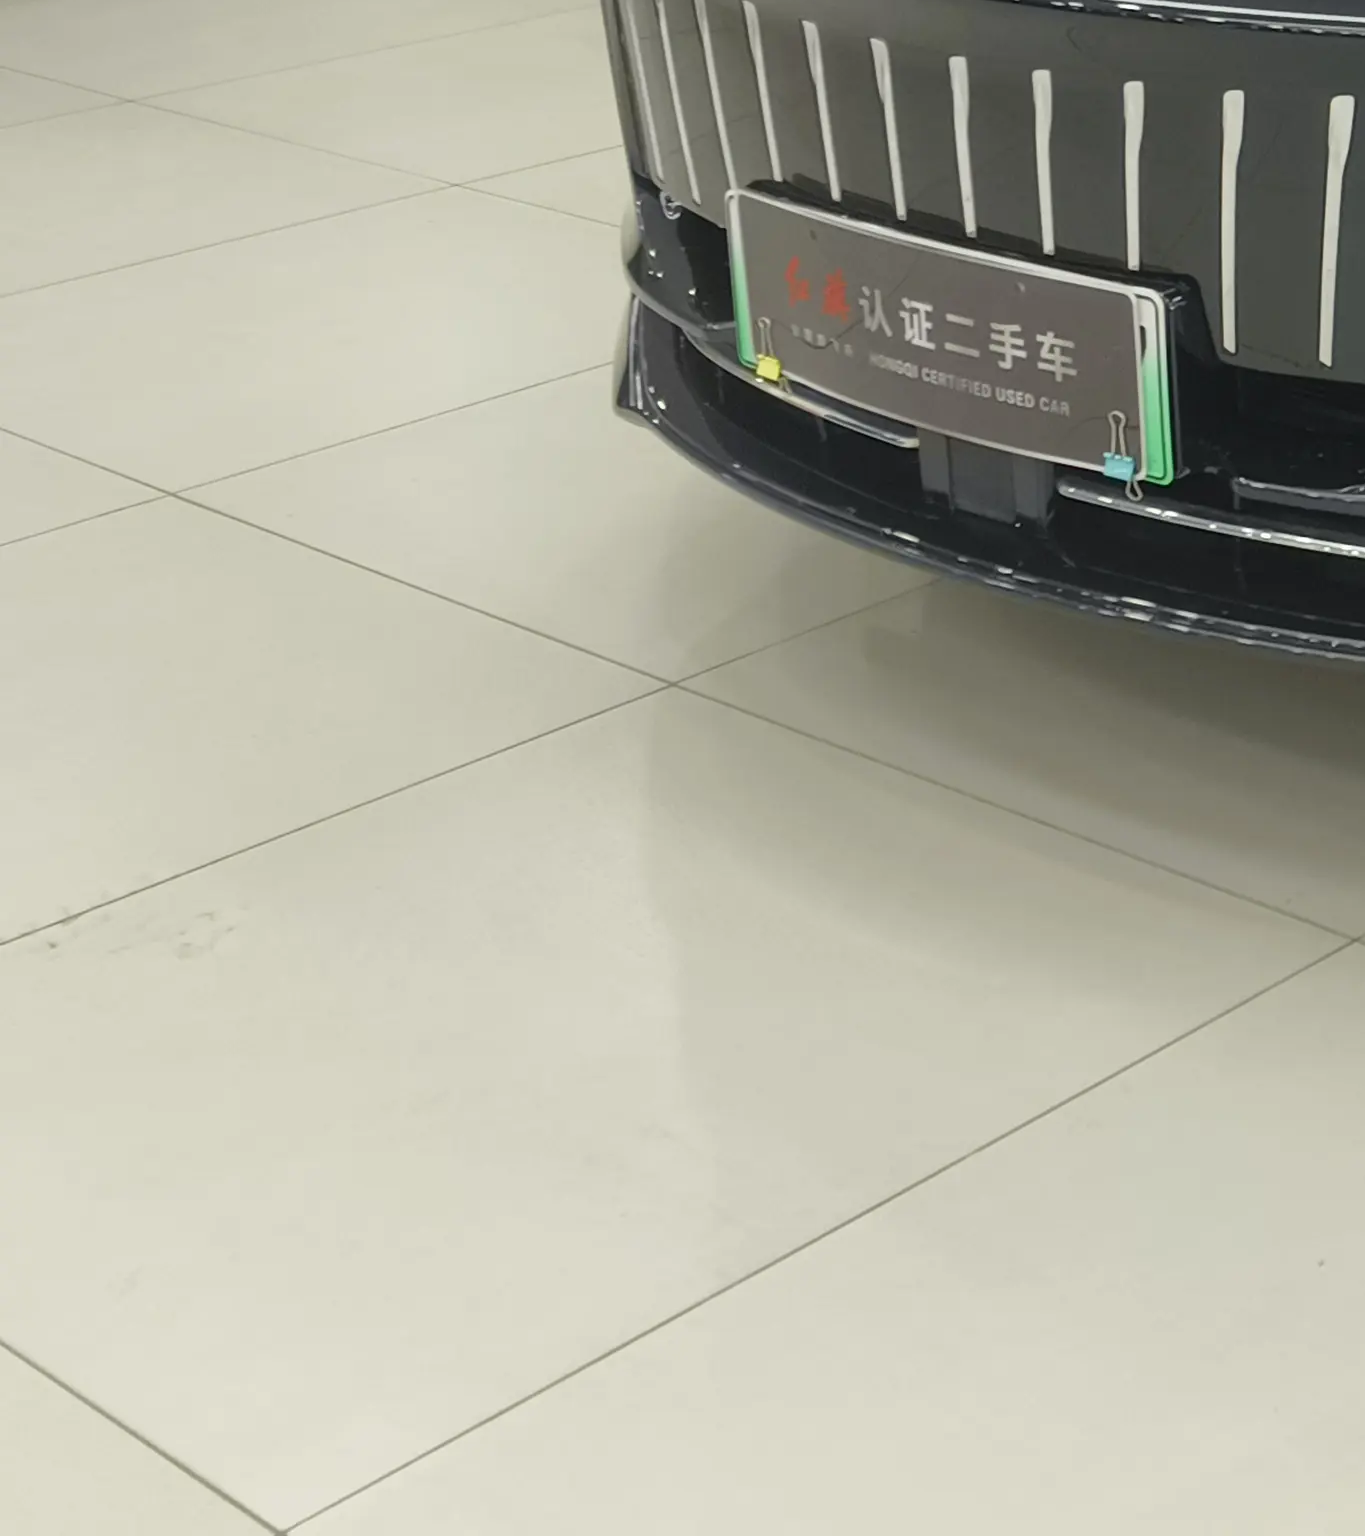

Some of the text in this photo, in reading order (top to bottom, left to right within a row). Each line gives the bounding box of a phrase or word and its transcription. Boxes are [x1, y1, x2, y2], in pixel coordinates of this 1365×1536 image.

[858, 285, 1079, 383] 认证二手车
[921, 366, 993, 400] CERTIFIED
[994, 383, 1036, 410] USED
[1038, 393, 1071, 418] CAR
